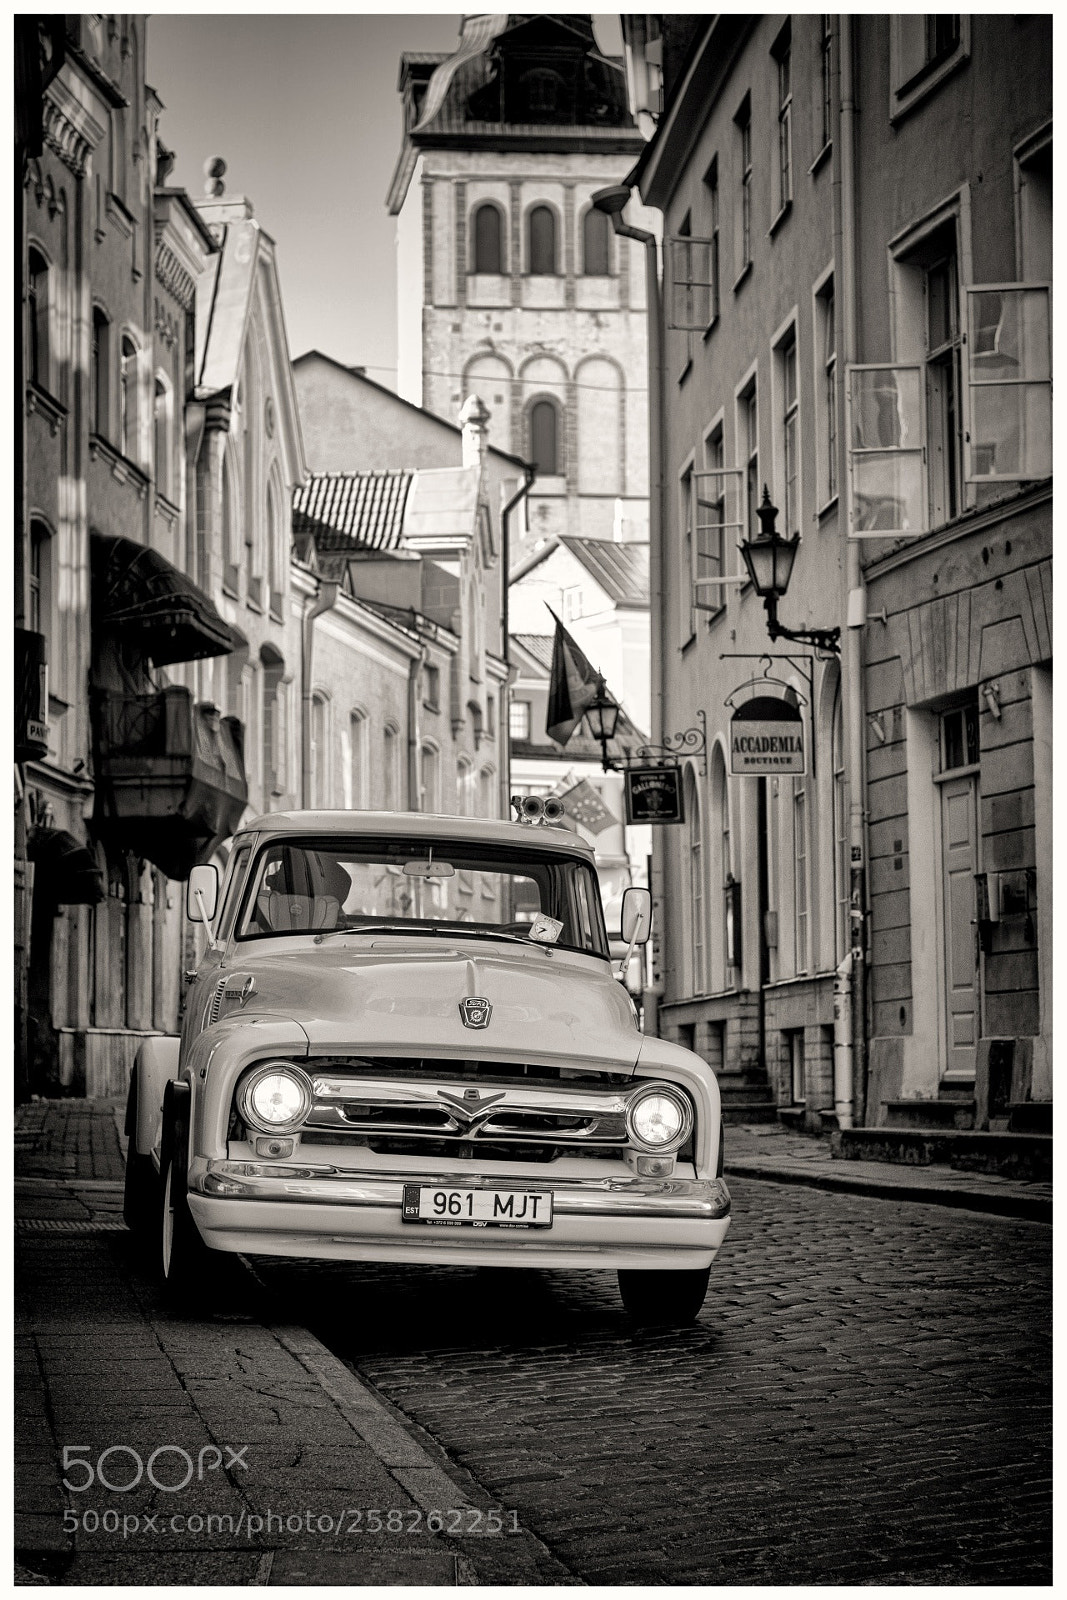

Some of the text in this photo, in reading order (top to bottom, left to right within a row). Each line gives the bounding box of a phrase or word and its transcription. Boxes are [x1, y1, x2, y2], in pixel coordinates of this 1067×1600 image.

[732, 736, 803, 753] ACCADEMIA
[743, 756, 793, 765] BOUTIQUE
[405, 1191, 542, 1219] EST 961 MJT
